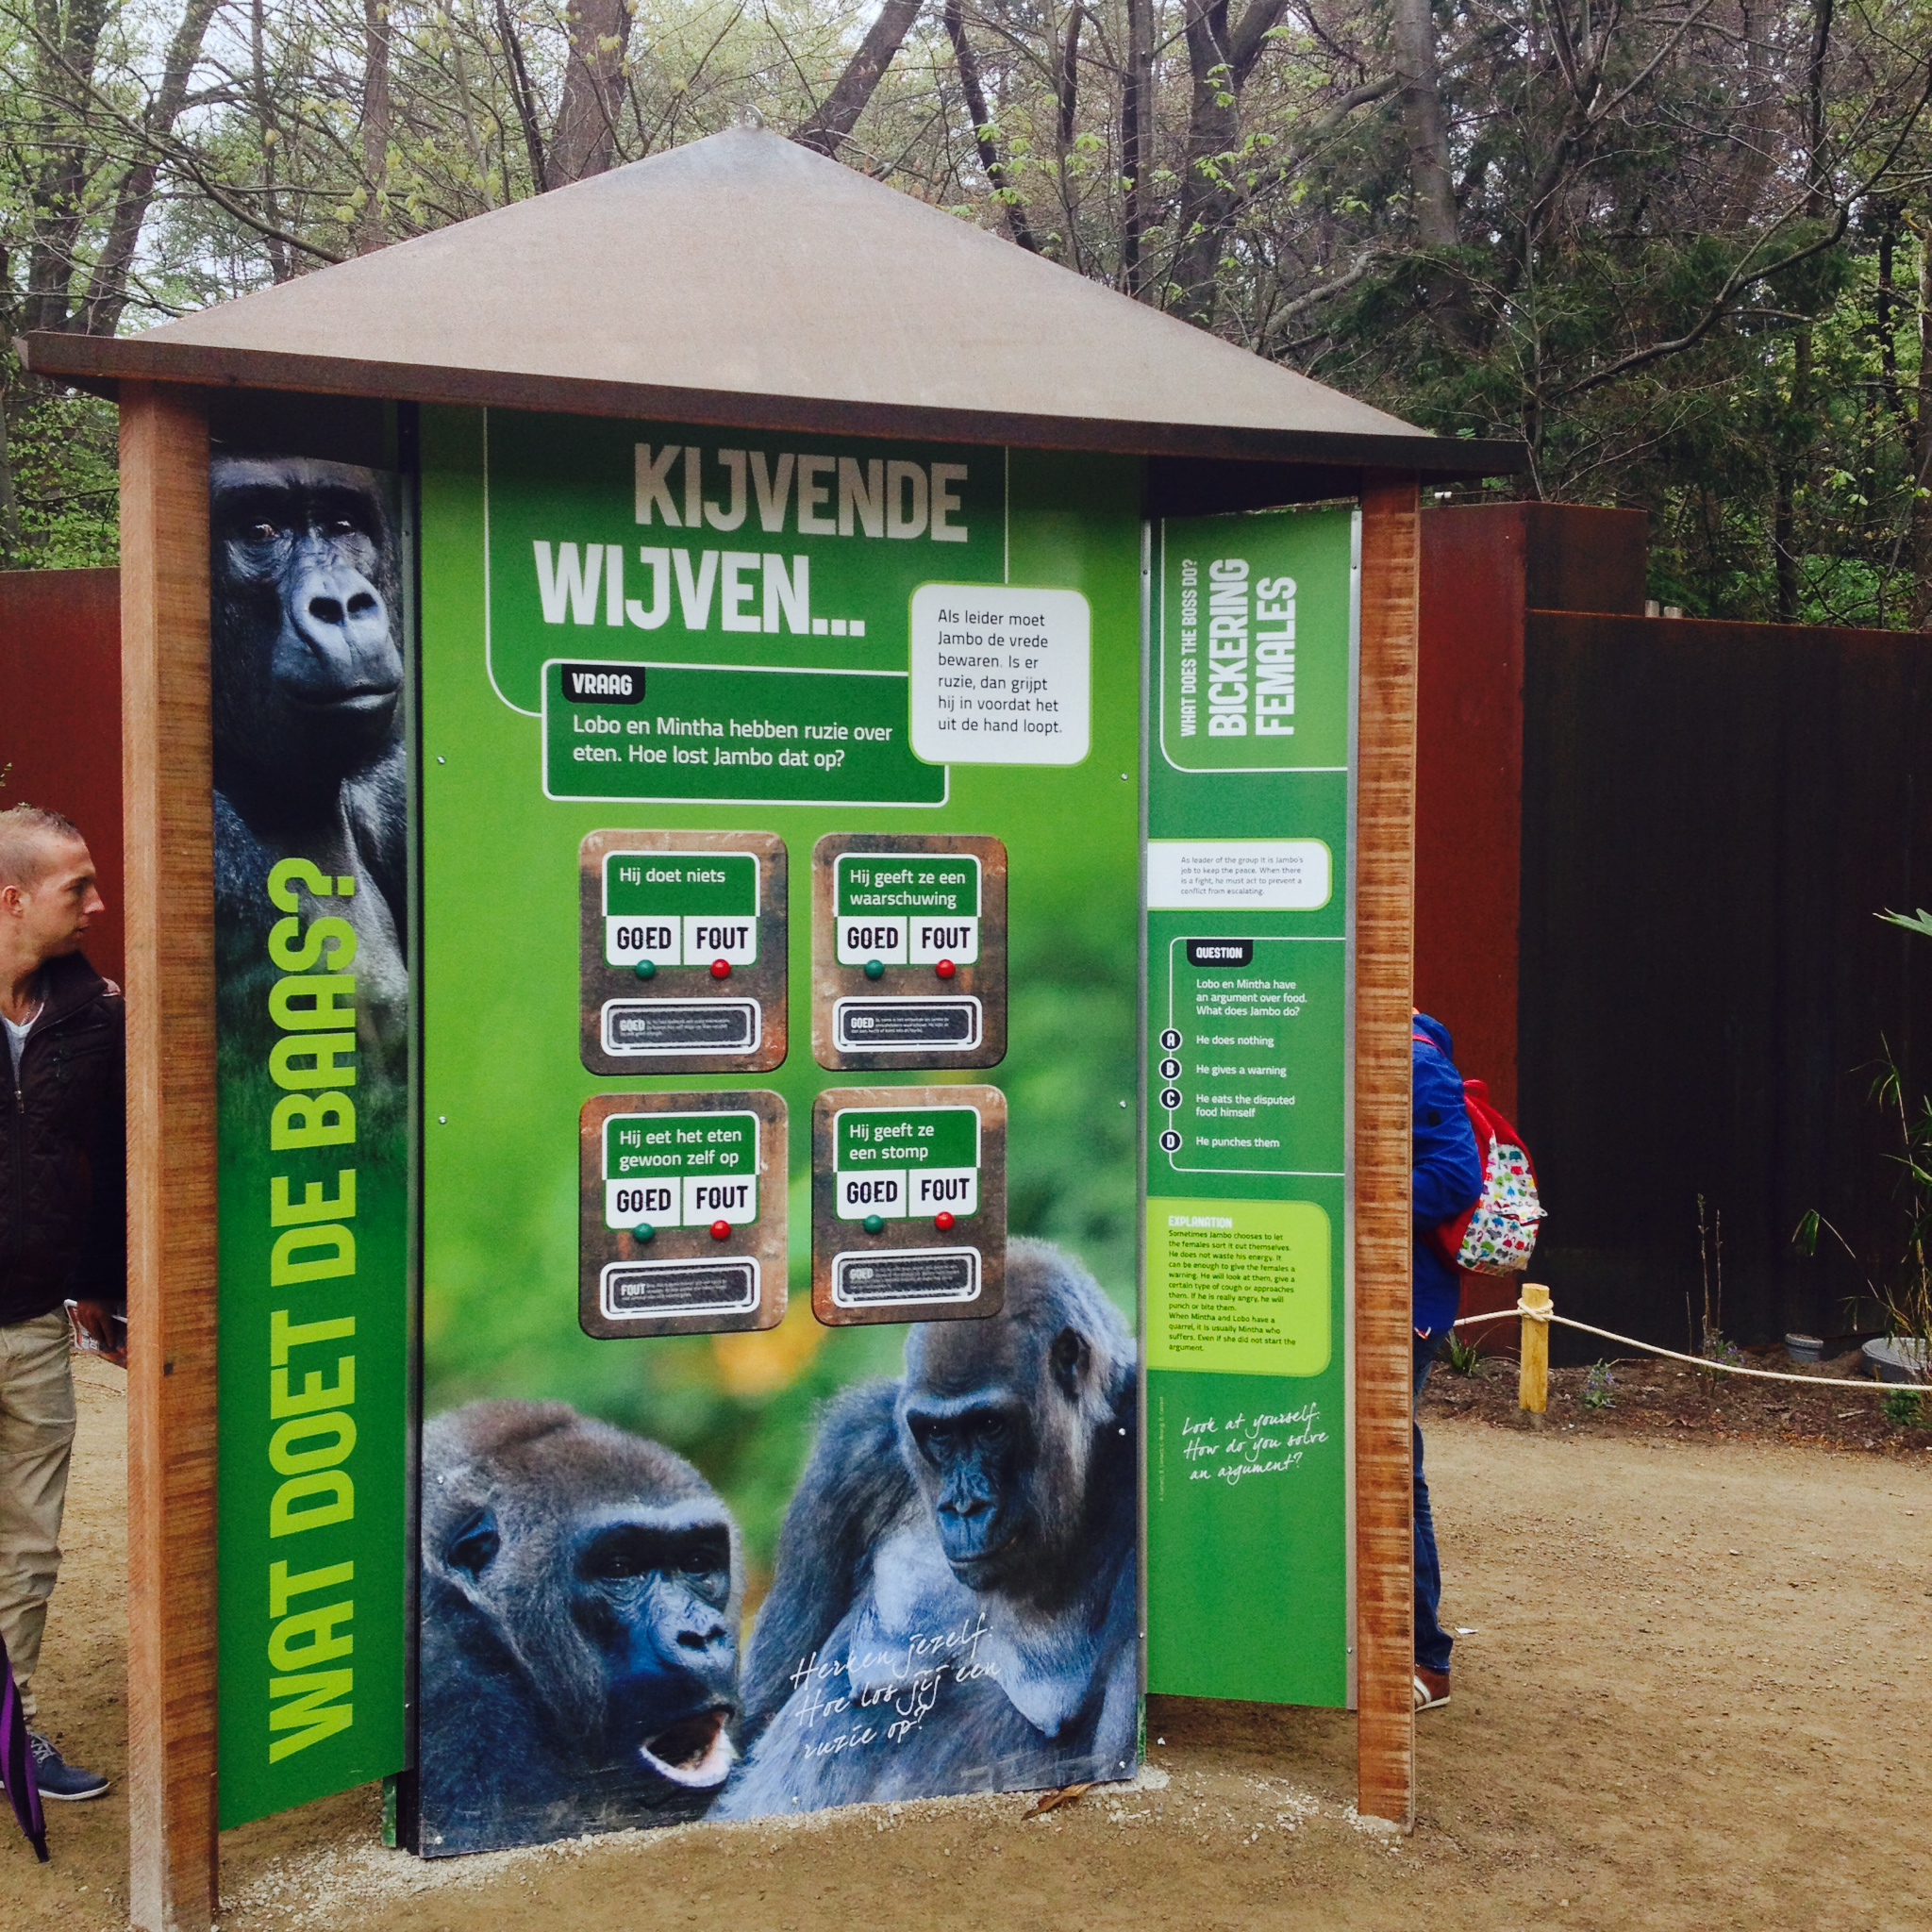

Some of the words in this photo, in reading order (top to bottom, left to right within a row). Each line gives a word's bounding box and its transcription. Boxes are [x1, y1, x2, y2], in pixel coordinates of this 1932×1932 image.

[635, 442, 968, 542] KIJVENDE
[1182, 558, 1197, 587] DO?
[532, 540, 866, 637] WIJVEN...
[938, 609, 959, 624] Als
[965, 610, 1003, 625] leider
[1009, 614, 1044, 626] moet
[1182, 591, 1197, 626] BOSS
[938, 631, 982, 645] Jambo
[989, 633, 1004, 646] de
[1009, 635, 1048, 648] vrede
[1181, 628, 1197, 656] THE
[1208, 558, 1249, 737] BICKERING
[939, 652, 1003, 668] bewaren.
[1009, 656, 1020, 668] Is
[1025, 658, 1039, 669] er
[1256, 576, 1297, 735] FEMALES
[572, 673, 633, 695] VRAAG
[939, 675, 975, 690] ruzie,
[981, 675, 1006, 689] dan
[1011, 676, 1047, 693] grijpt
[1181, 658, 1196, 694] DOES
[939, 695, 955, 712] hij
[960, 696, 972, 709] in
[978, 698, 1030, 711] voordat
[1037, 698, 1058, 712] het
[1181, 697, 1196, 737] WHAT
[573, 714, 622, 734] Lobo
[626, 720, 650, 734] en
[657, 716, 724, 737] Mintha
[730, 719, 798, 739] hebben
[805, 723, 848, 740] ruzie
[854, 725, 892, 741] over
[939, 718, 956, 730] uit
[962, 718, 978, 731] de
[984, 718, 1018, 732] hand
[1024, 719, 1062, 736] loopt.
[573, 744, 622, 761] eten.
[629, 744, 667, 763] Hoe
[673, 745, 708, 764] lost
[714, 746, 773, 766] Jambo
[778, 748, 808, 767] dat
[814, 750, 845, 772] op?
[620, 868, 641, 886] Hij
[645, 868, 681, 883] doet
[687, 869, 725, 883] niets
[850, 870, 870, 887] Hij
[874, 870, 913, 887] geeft
[918, 873, 935, 884] ze
[940, 873, 965, 884] een
[1203, 867, 1220, 875] keep
[850, 891, 957, 909] waarschuwing
[617, 926, 672, 949] GOED
[696, 926, 749, 949] FOUT
[847, 926, 898, 949] GOED
[922, 926, 971, 949] FOUT
[1196, 947, 1242, 958] QUESTION
[1196, 979, 1220, 989] Lobo
[1237, 979, 1271, 989] Mintha
[1274, 979, 1296, 989] have
[267, 858, 358, 1150] BAAS?
[1211, 993, 1257, 1005] argument
[1283, 993, 1307, 1003] food.
[1196, 1006, 1222, 1015] What
[1224, 1007, 1247, 1015] does
[1250, 1007, 1280, 1016] Jambo
[1283, 1007, 1300, 1016] do?
[619, 1019, 645, 1032] GOED
[851, 1017, 874, 1029] GOED
[1166, 1033, 1175, 1047] A
[1196, 1036, 1209, 1044] He
[1212, 1036, 1235, 1045] does
[1238, 1036, 1274, 1048] nothing
[1166, 1062, 1174, 1075] B
[1196, 1064, 1209, 1074] He
[1212, 1065, 1236, 1076] gives
[1248, 1066, 1287, 1077] warning
[1167, 1091, 1174, 1106] C
[1196, 1094, 1209, 1103] He
[1212, 1095, 1232, 1104] eats
[1235, 1094, 1251, 1104] the
[1254, 1095, 1295, 1107] disputed
[1196, 1107, 1217, 1117] food
[1221, 1108, 1256, 1117] himself
[620, 1131, 641, 1148] Hij
[645, 1131, 672, 1145] eet
[676, 1129, 702, 1144] het
[708, 1130, 741, 1142] eten
[850, 1124, 870, 1141] Hij
[874, 1123, 913, 1141] geeft
[918, 1125, 934, 1137] ze
[1167, 1135, 1174, 1148] D
[1196, 1137, 1209, 1145] He
[1212, 1137, 1251, 1148] punches
[1254, 1139, 1280, 1147] them
[619, 1153, 681, 1172] gewoon
[687, 1150, 715, 1165] zelf
[720, 1152, 739, 1167] op
[849, 1147, 876, 1159] een
[882, 1146, 928, 1161] stomp
[616, 1188, 672, 1212] GOED
[696, 1185, 748, 1209] FOUT
[847, 1181, 898, 1204] GOED
[922, 1178, 971, 1201] FOUT
[271, 1169, 356, 1287] DE
[1168, 1216, 1232, 1228] EXPLANATION
[1169, 1229, 1208, 1239] Sometimes
[1209, 1230, 1232, 1239] Jambo
[1234, 1231, 1262, 1240] chooses
[621, 1283, 646, 1296] FOUT
[1169, 1343, 1204, 1352] argument.
[268, 1309, 357, 1539] DOET
[1182, 1417, 1219, 1436] Look
[1225, 1412, 1245, 1429] at
[1245, 1402, 1321, 1439] yourself:
[1183, 1437, 1220, 1461] How
[1226, 1439, 1246, 1453] do
[1245, 1437, 1281, 1462] you
[1287, 1427, 1329, 1447] solve
[1190, 1469, 1211, 1480] an
[1218, 1452, 1303, 1485] argument?
[790, 1651, 894, 1690] Herken
[891, 1611, 994, 1679] jezelf:
[267, 1559, 354, 1764] WAT
[795, 1689, 850, 1727] Hoe
[861, 1681, 898, 1707] los
[896, 1665, 950, 1716] jij
[956, 1661, 1002, 1683] een
[804, 1724, 877, 1760] ruzie
[888, 1706, 928, 1743] op?
